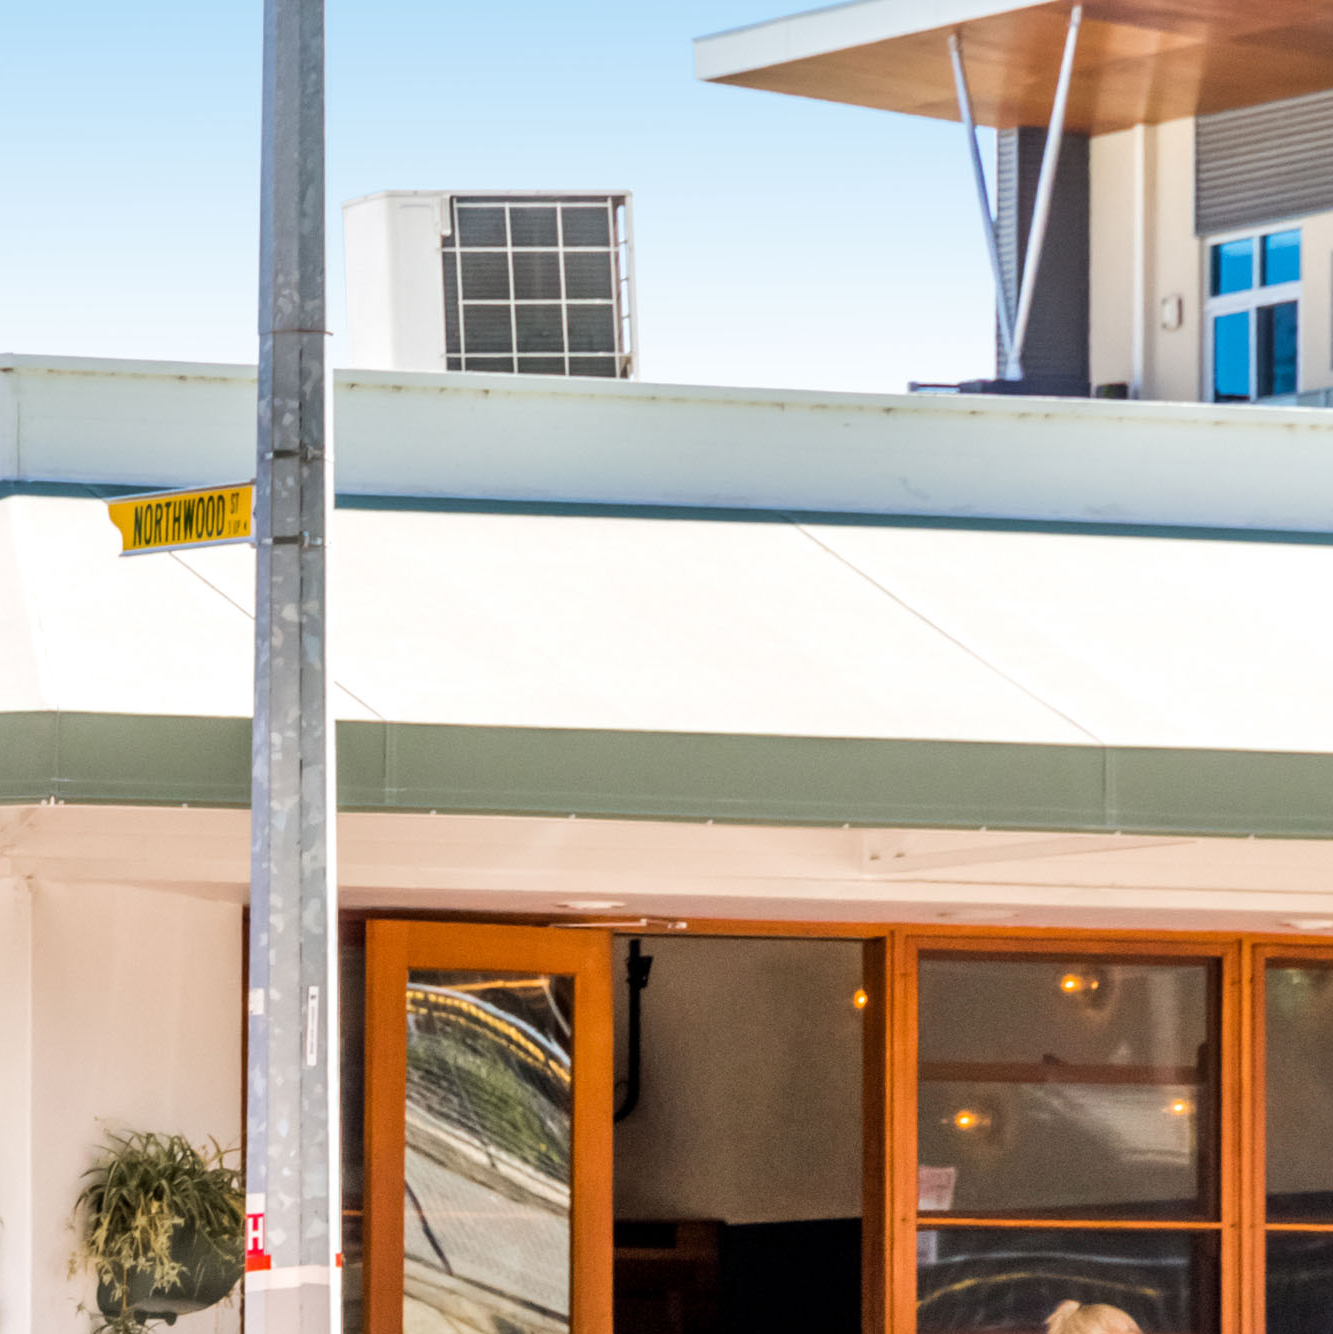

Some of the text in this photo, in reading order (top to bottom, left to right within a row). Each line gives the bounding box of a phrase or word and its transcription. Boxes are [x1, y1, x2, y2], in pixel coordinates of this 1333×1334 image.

[133, 494, 226, 547] NORTHWOOD
[229, 491, 240, 515] ST
[247, 1217, 264, 1250] H
